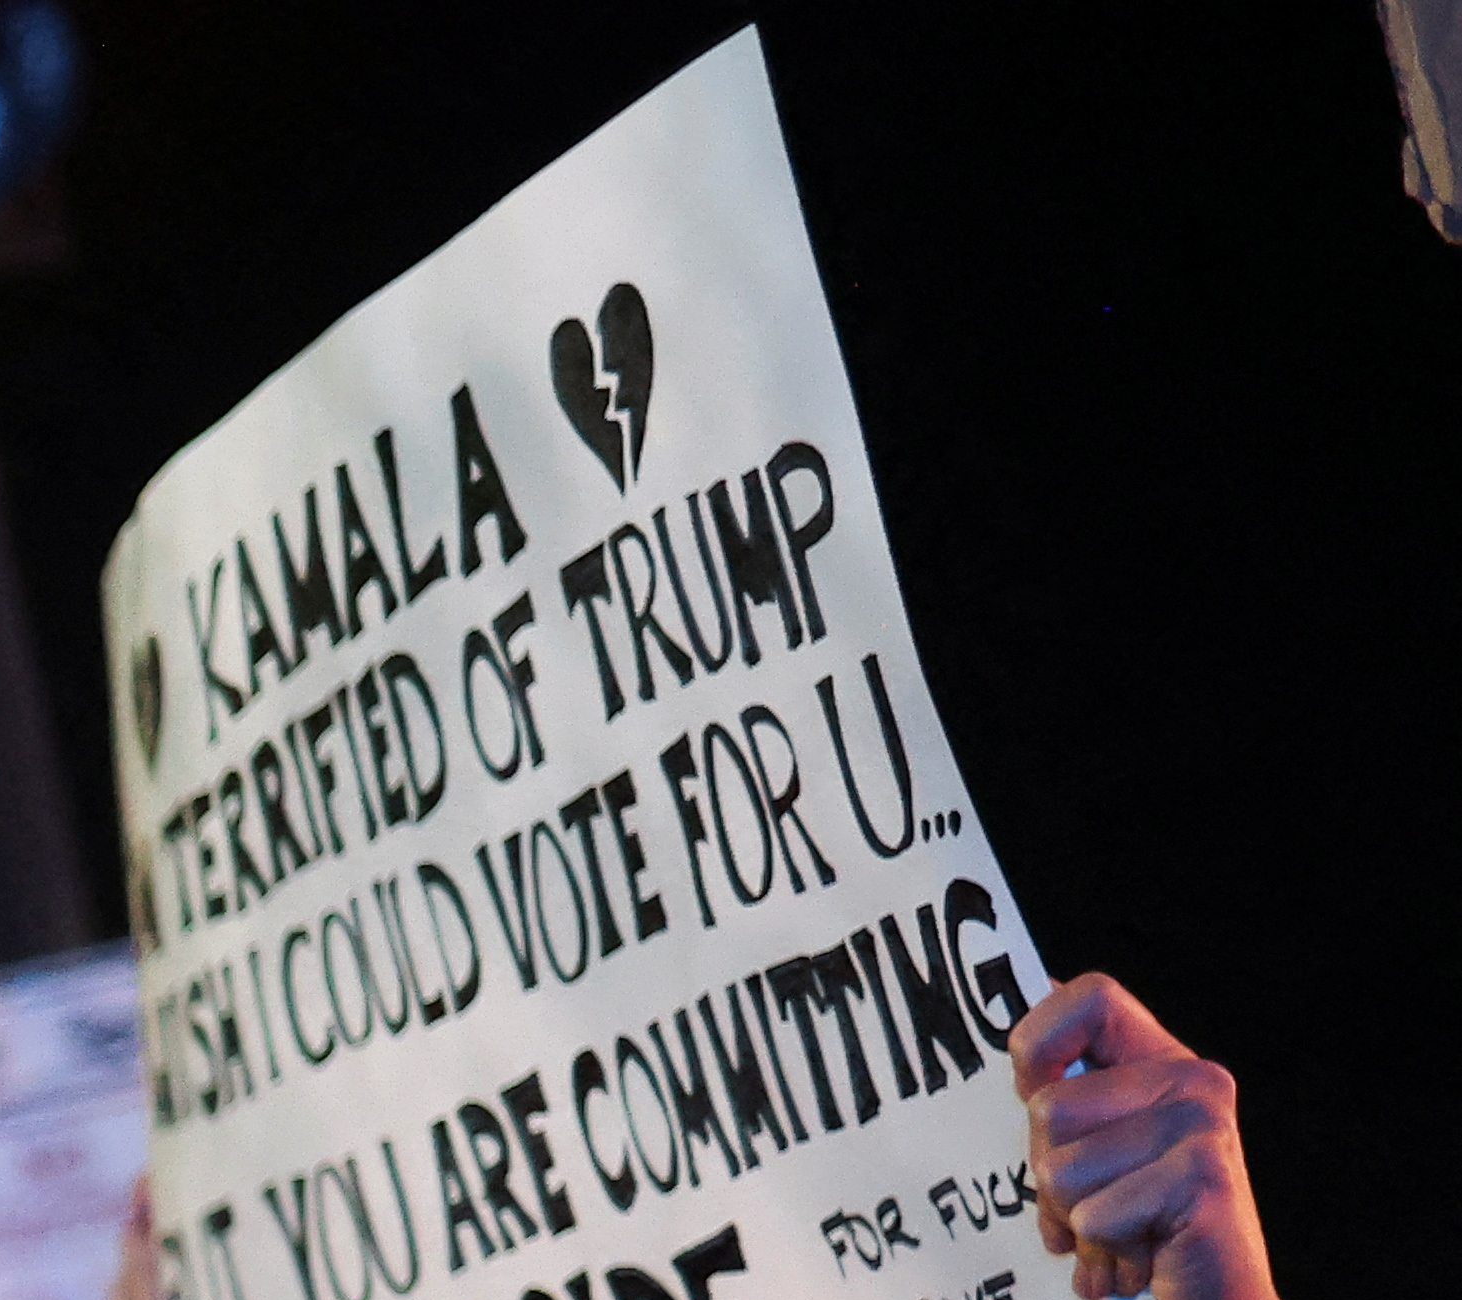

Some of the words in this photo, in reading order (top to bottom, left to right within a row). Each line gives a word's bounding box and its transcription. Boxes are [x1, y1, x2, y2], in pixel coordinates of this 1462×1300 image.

[163, 652, 447, 933] TERRIFIED
[461, 588, 547, 783] OF
[559, 441, 835, 724] TRUMP
[187, 383, 527, 745] KAMALA
[247, 948, 282, 1084] I
[282, 862, 482, 1068] COULD
[475, 766, 669, 993] VOTE
[659, 703, 838, 931] FOR
[430, 1070, 578, 1273] ARE
[571, 876, 1027, 1214] COMMITTING
[819, 1196, 921, 1280] FOR
[927, 1159, 1038, 1241] FUCK
